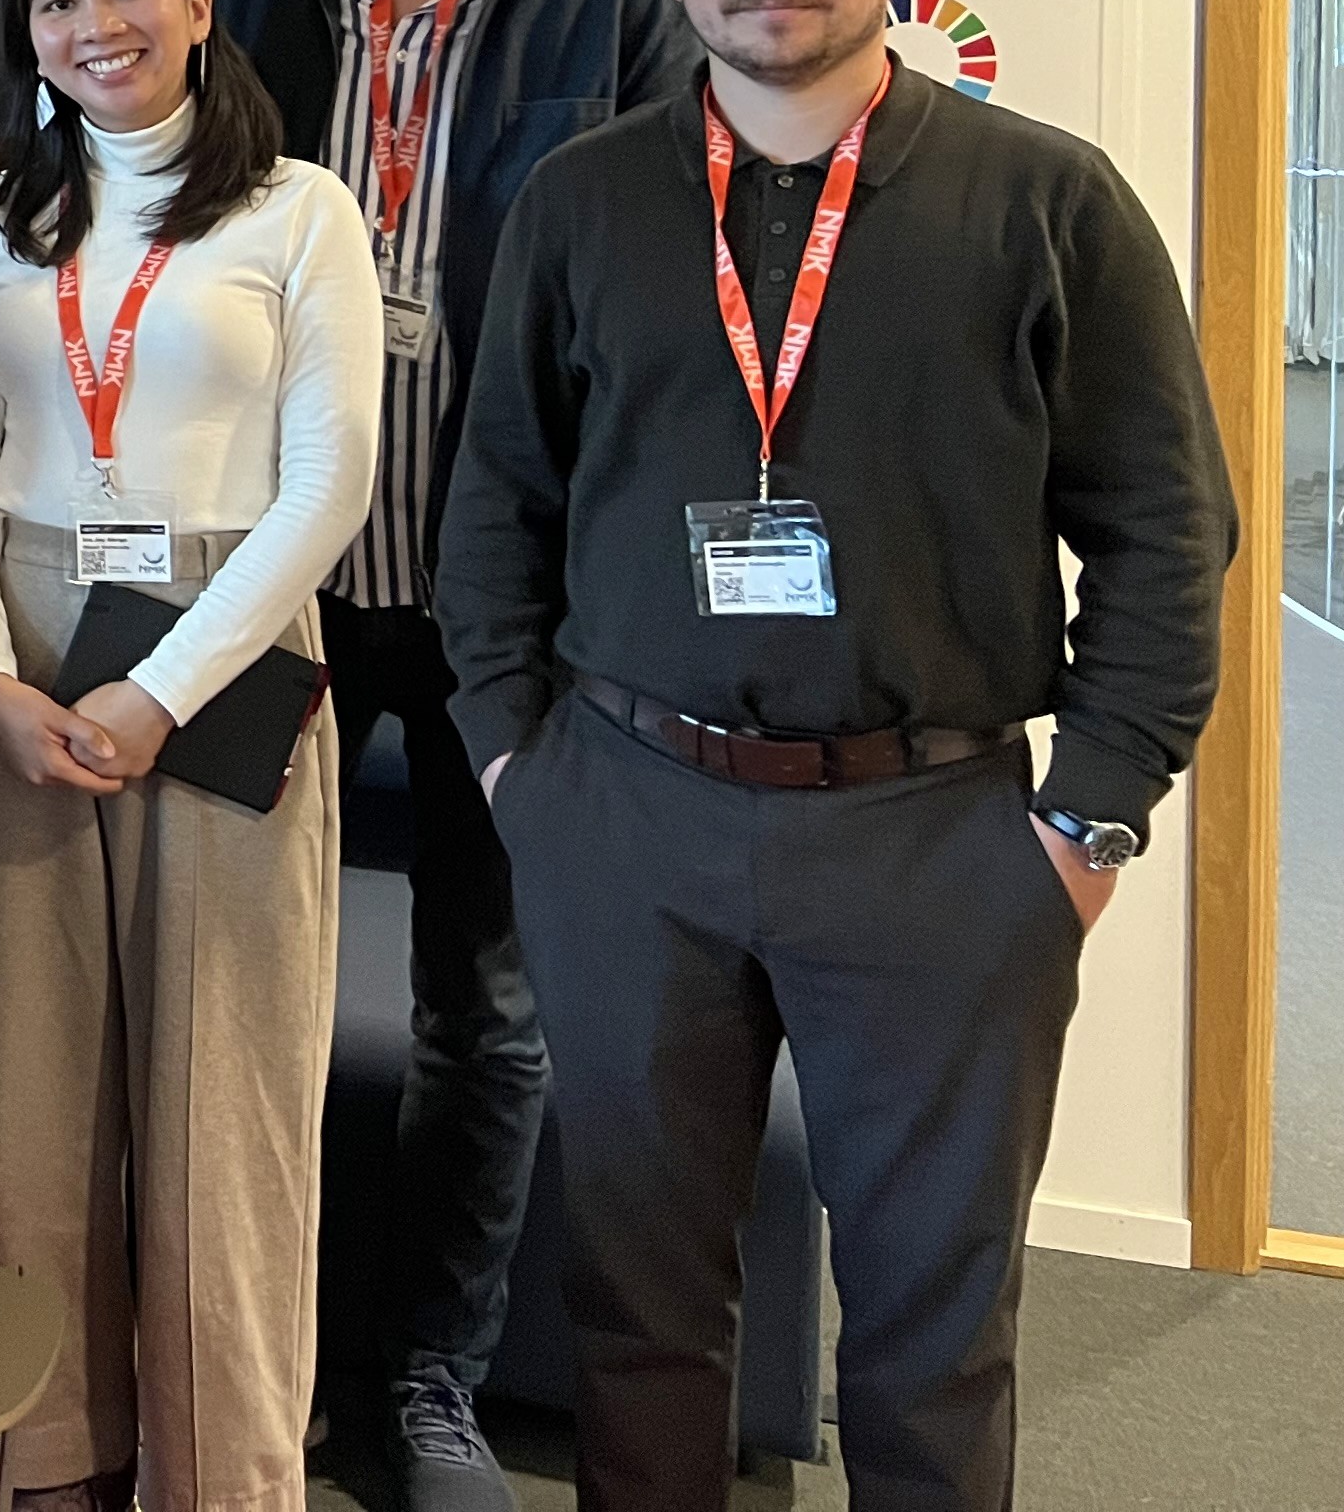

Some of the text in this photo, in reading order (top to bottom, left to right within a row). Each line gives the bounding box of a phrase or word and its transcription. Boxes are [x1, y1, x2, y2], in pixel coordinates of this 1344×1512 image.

[370, 20, 389, 74] NMK
[373, 114, 392, 171] NMK
[396, 115, 426, 171] NMK
[803, 208, 843, 274] NMK
[65, 337, 97, 398] NMK
[101, 328, 133, 389] NMK
[727, 322, 763, 389] NMK
[774, 323, 811, 390] NMK
